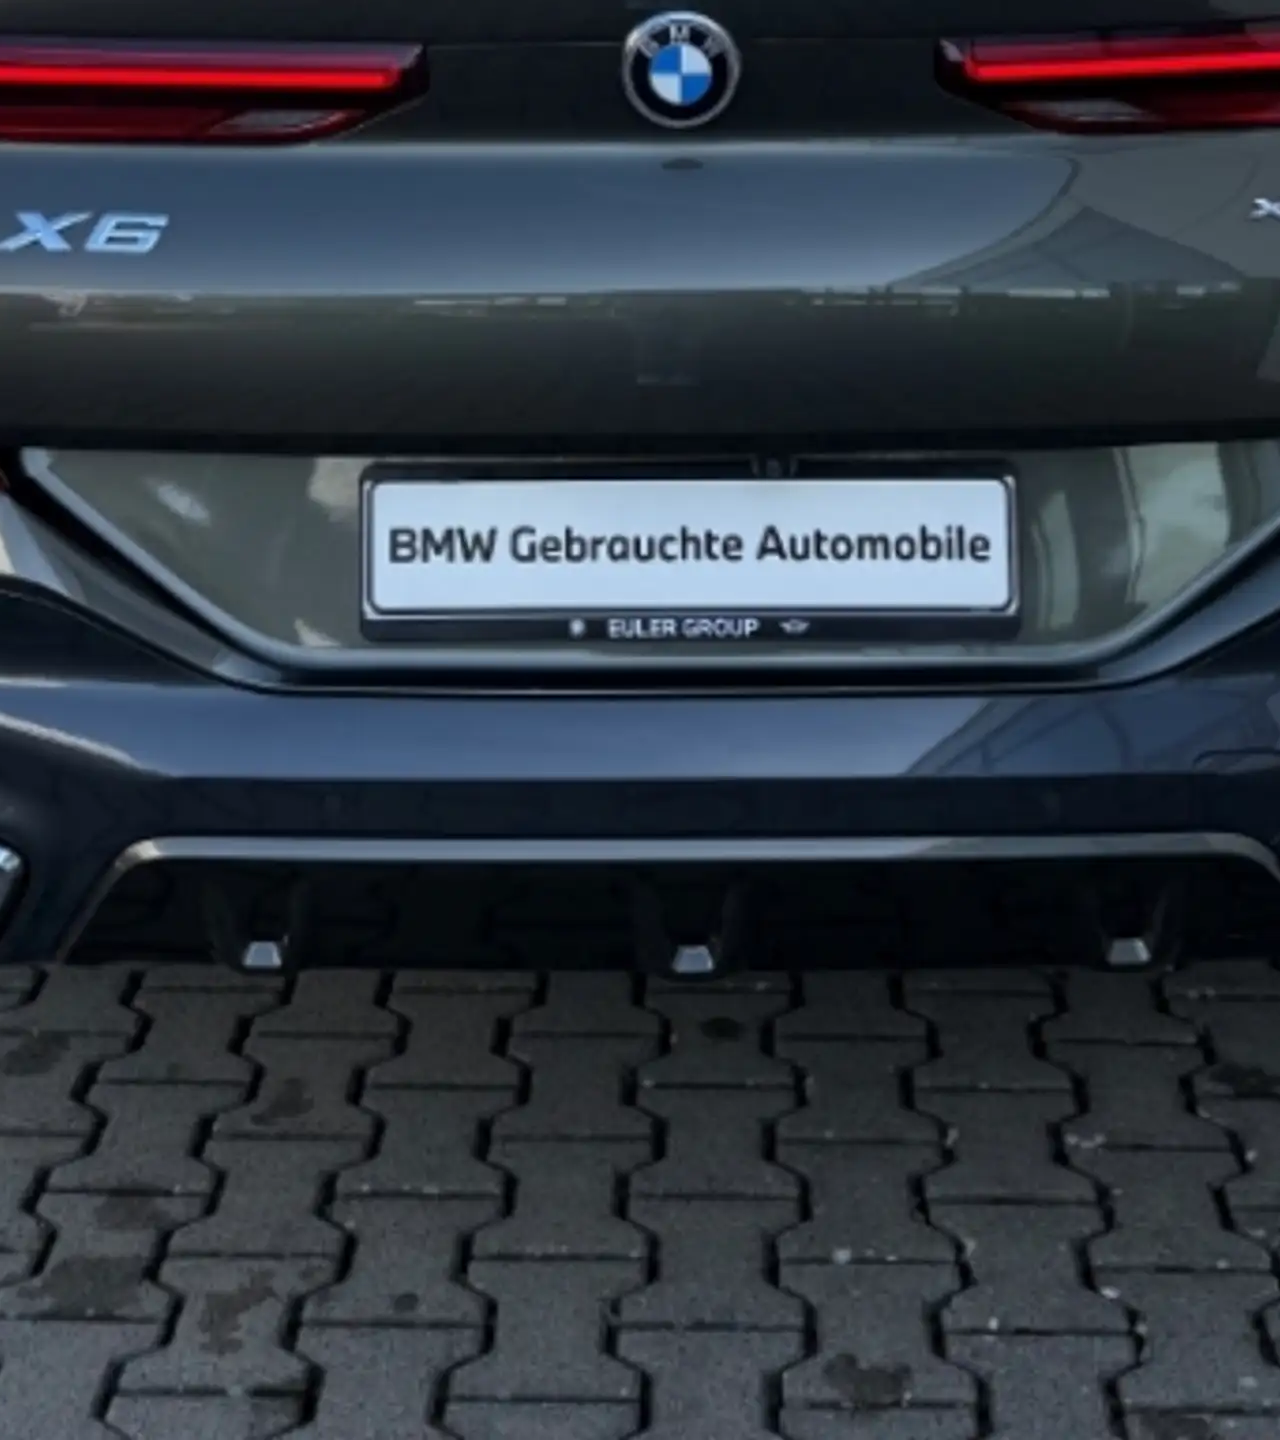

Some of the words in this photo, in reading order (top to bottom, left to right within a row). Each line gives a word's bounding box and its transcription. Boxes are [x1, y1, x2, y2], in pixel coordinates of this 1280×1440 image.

[388, 526, 498, 563] BMW
[509, 525, 744, 563] Gebrauchte
[756, 524, 992, 562] Automobile
[607, 617, 677, 639] EULER
[681, 617, 761, 638] GROUP
